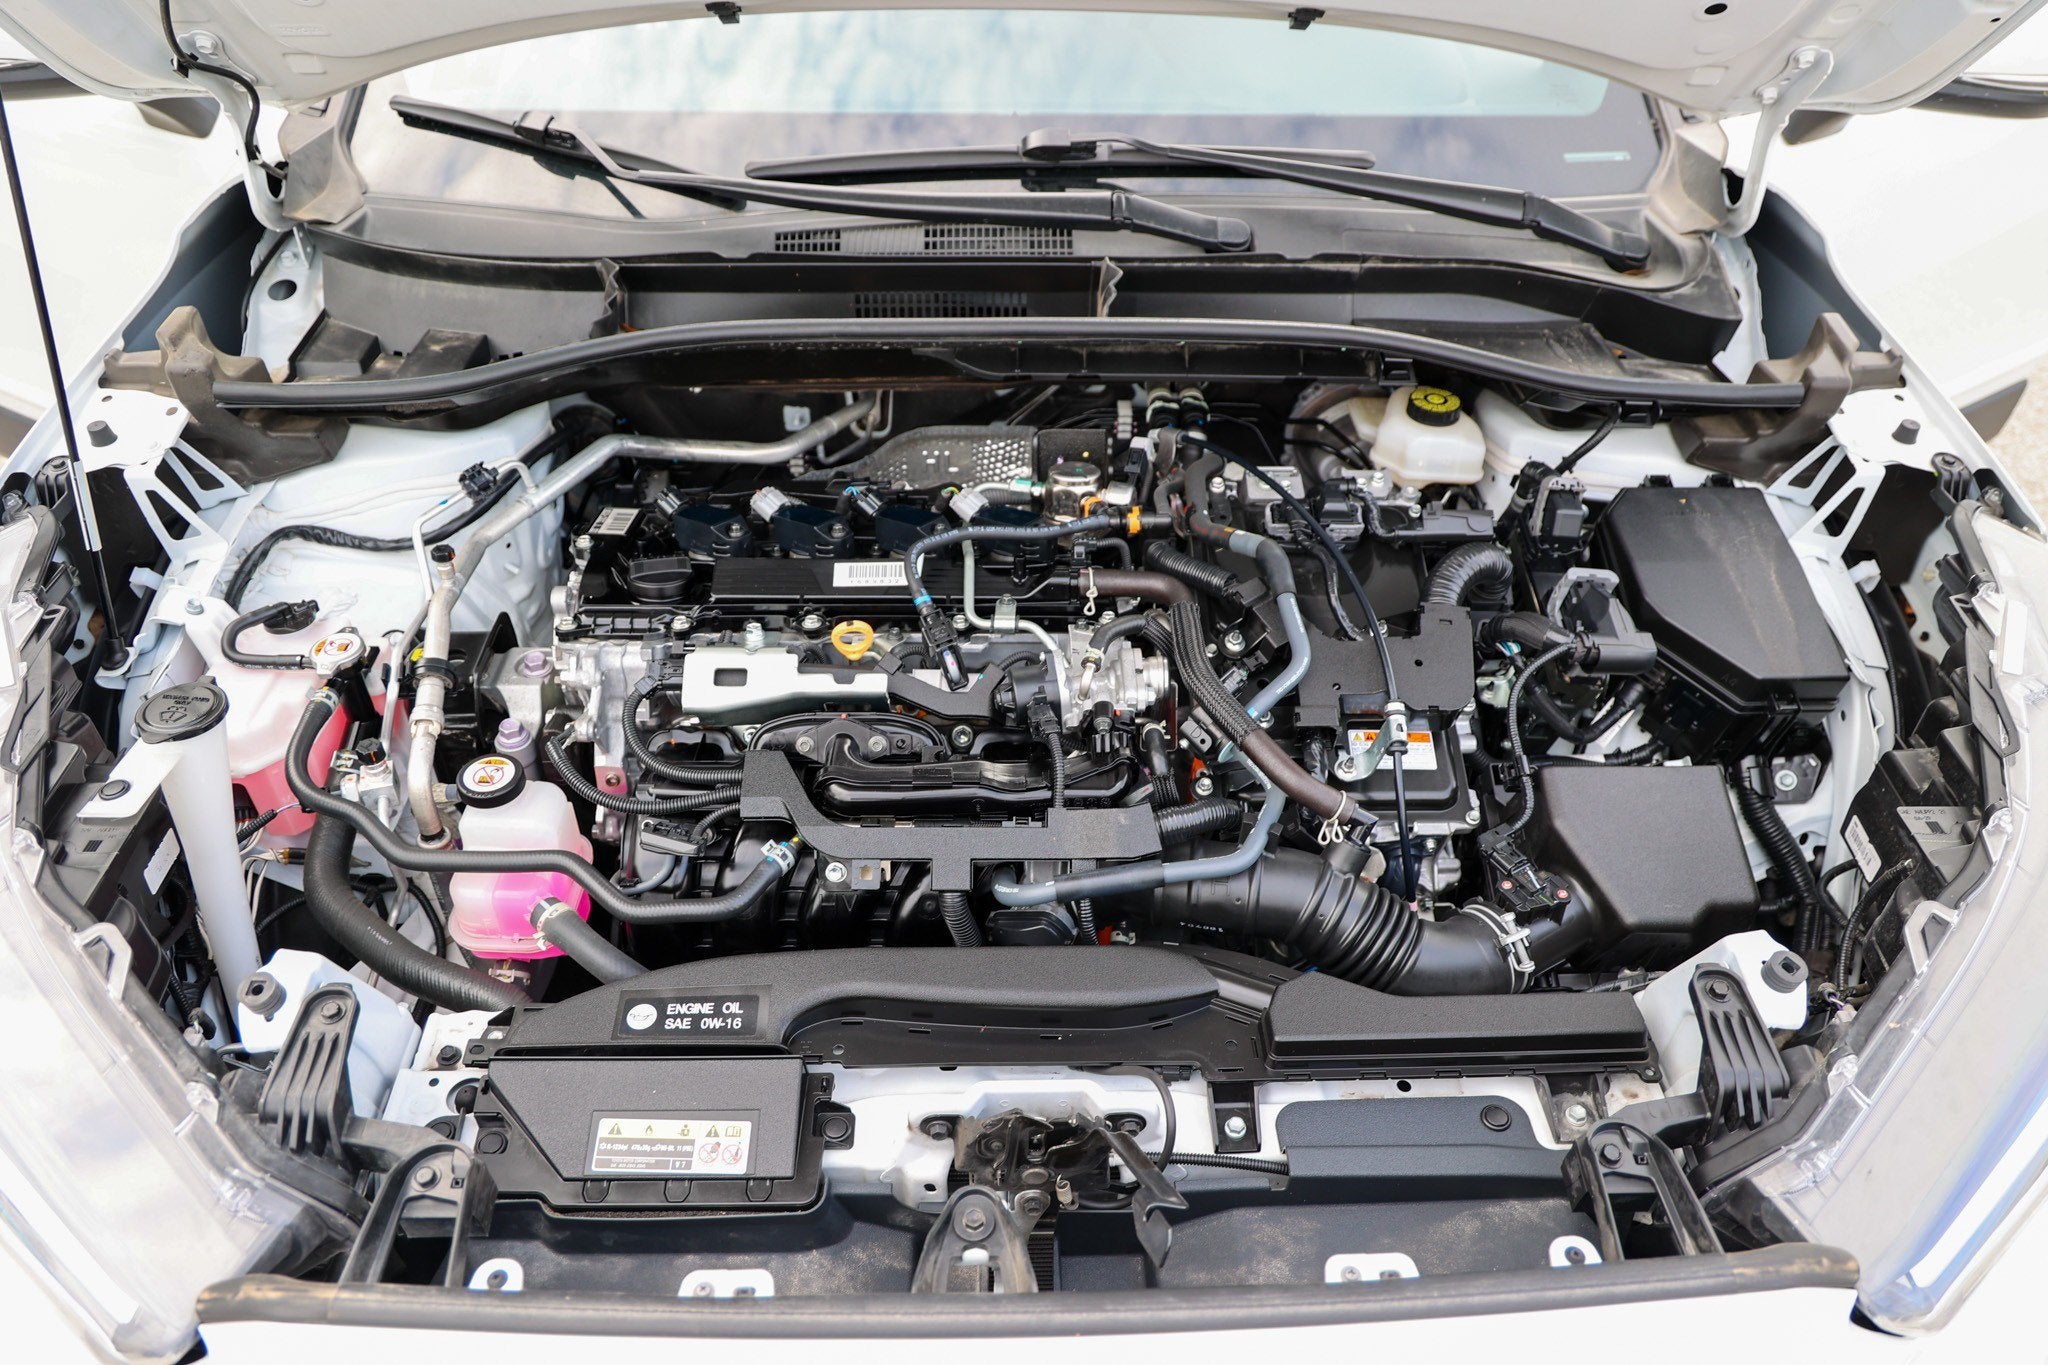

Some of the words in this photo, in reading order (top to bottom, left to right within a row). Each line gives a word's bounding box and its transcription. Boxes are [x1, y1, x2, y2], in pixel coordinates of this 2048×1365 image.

[666, 1002, 715, 1015] ENGINE
[721, 1001, 744, 1014] OIL
[664, 1017, 692, 1030] SAE
[700, 1017, 742, 1030] 0W-16
